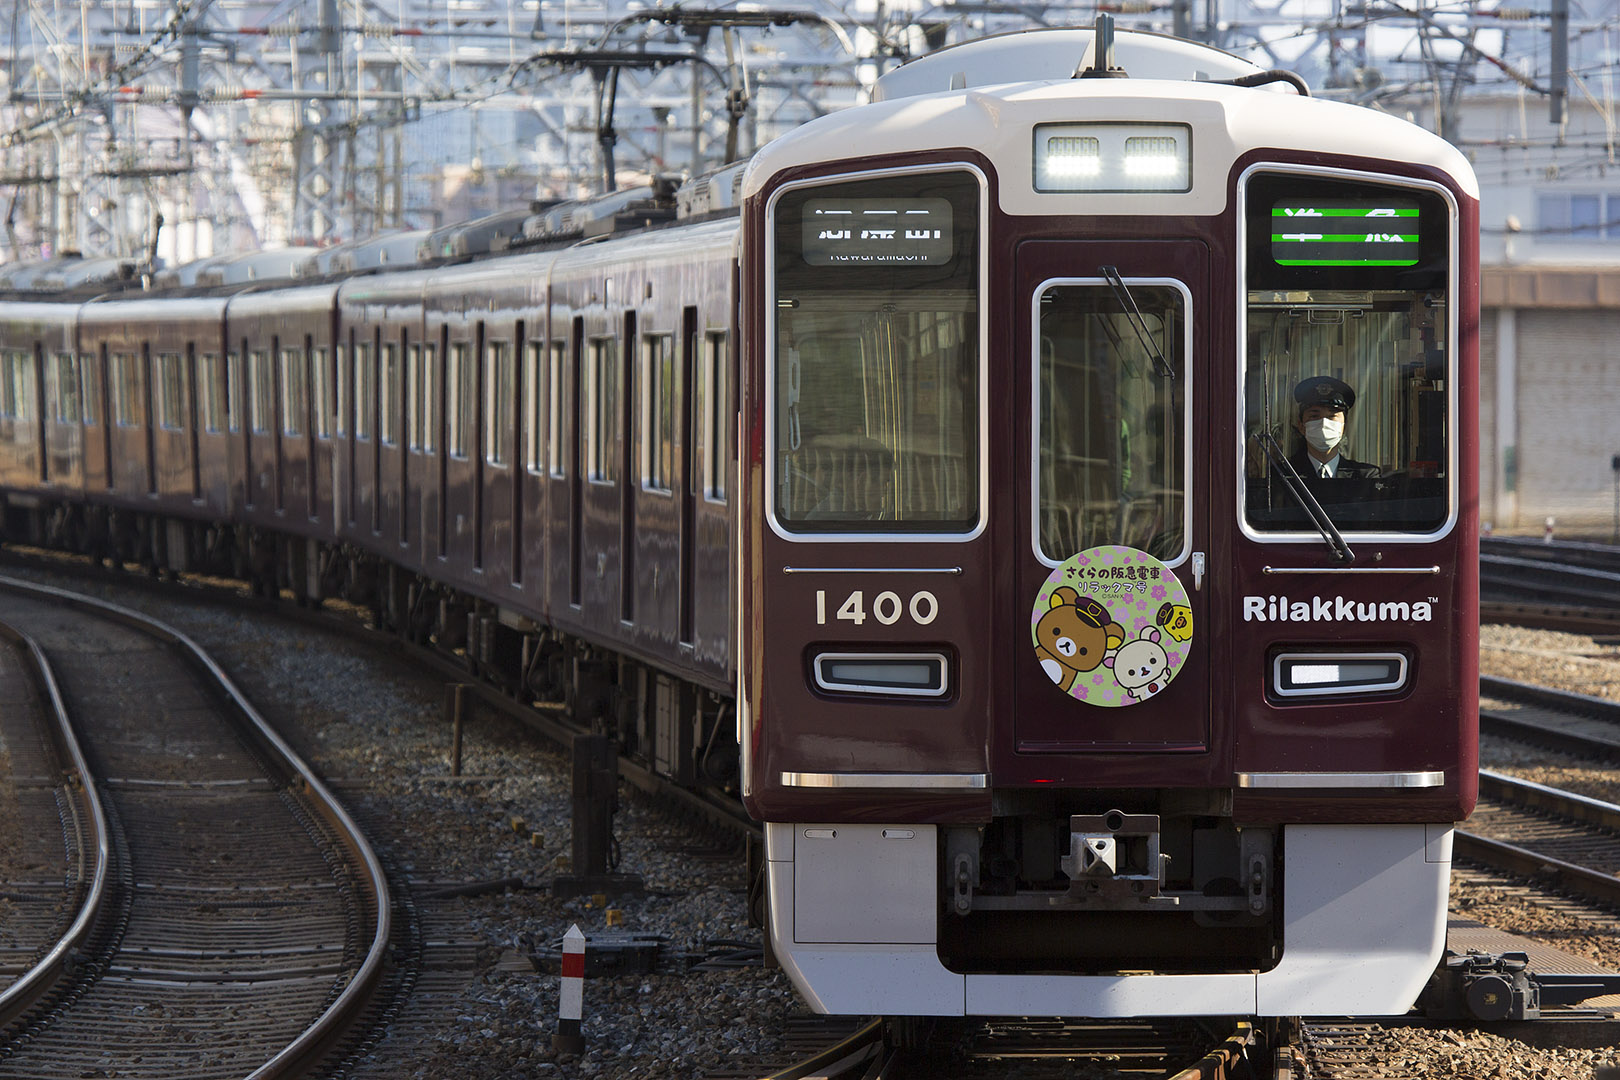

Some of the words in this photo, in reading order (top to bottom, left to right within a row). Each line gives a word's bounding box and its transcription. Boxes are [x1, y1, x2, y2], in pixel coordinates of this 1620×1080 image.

[1066, 566, 1160, 580] さくらの阪急電車
[1078, 581, 1148, 593] リラックマ号
[816, 590, 939, 625] 1400
